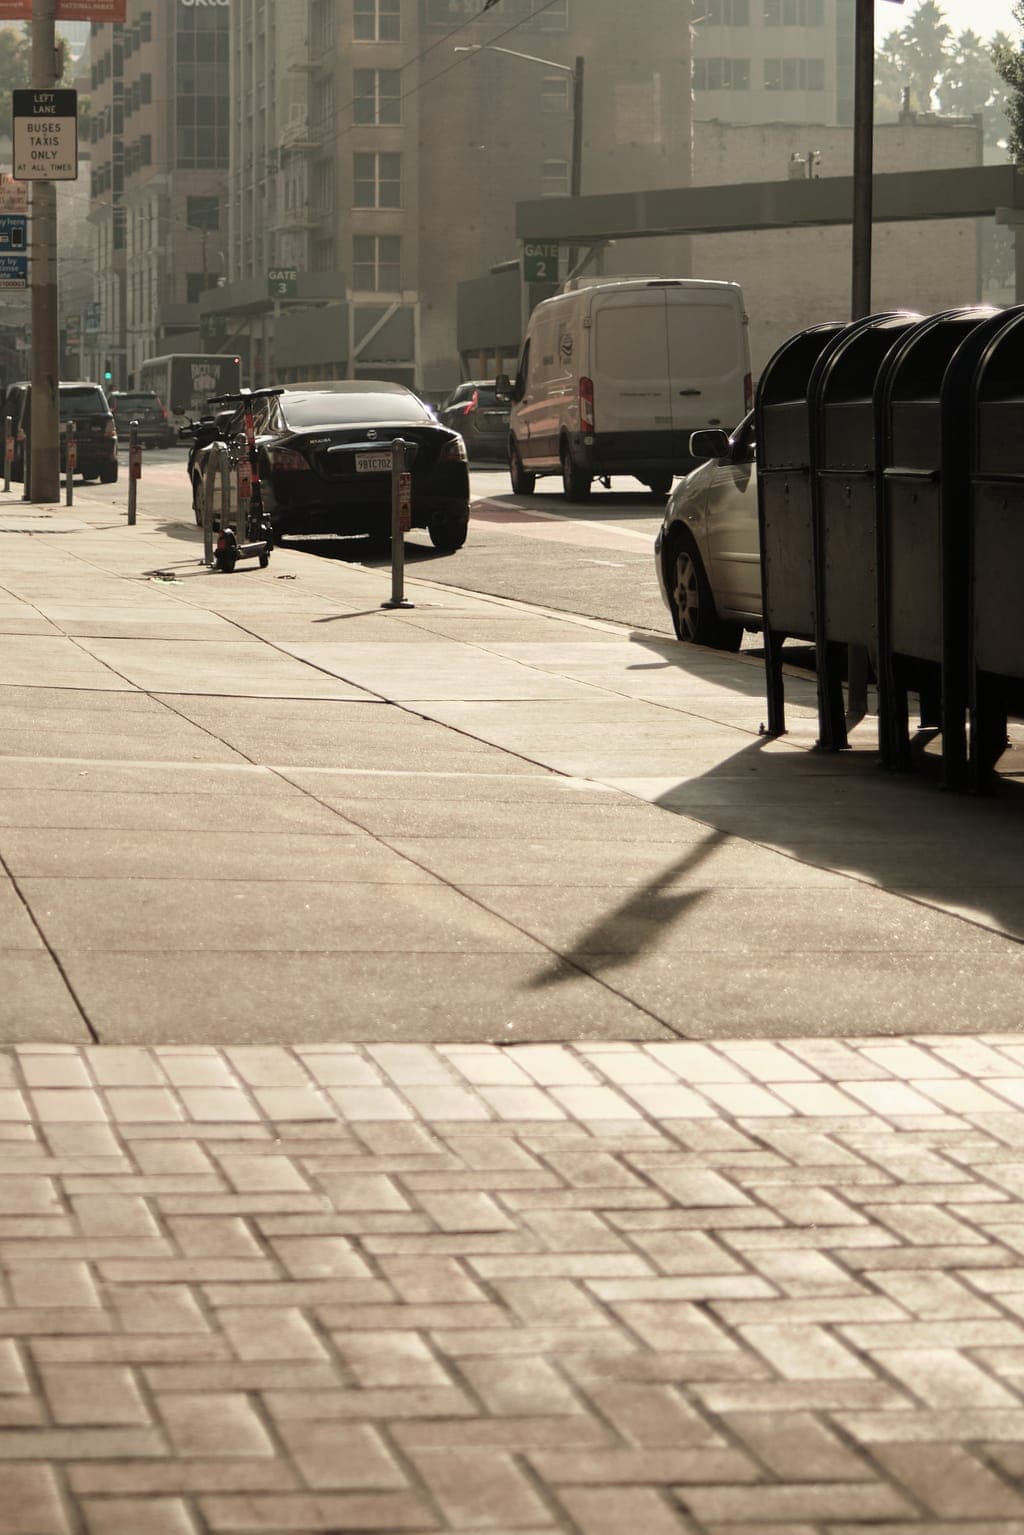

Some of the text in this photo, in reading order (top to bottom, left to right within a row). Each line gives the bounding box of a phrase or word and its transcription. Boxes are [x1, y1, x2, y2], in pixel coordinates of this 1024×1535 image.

[33, 93, 55, 103] LEFT
[33, 105, 56, 114] LANE
[27, 123, 61, 133] BUSES
[30, 137, 59, 146] TAXIS
[31, 151, 58, 160] ONLY
[525, 244, 558, 256] GATE
[537, 262, 546, 276] 2
[268, 270, 297, 280] GATE
[278, 282, 288, 294] 3
